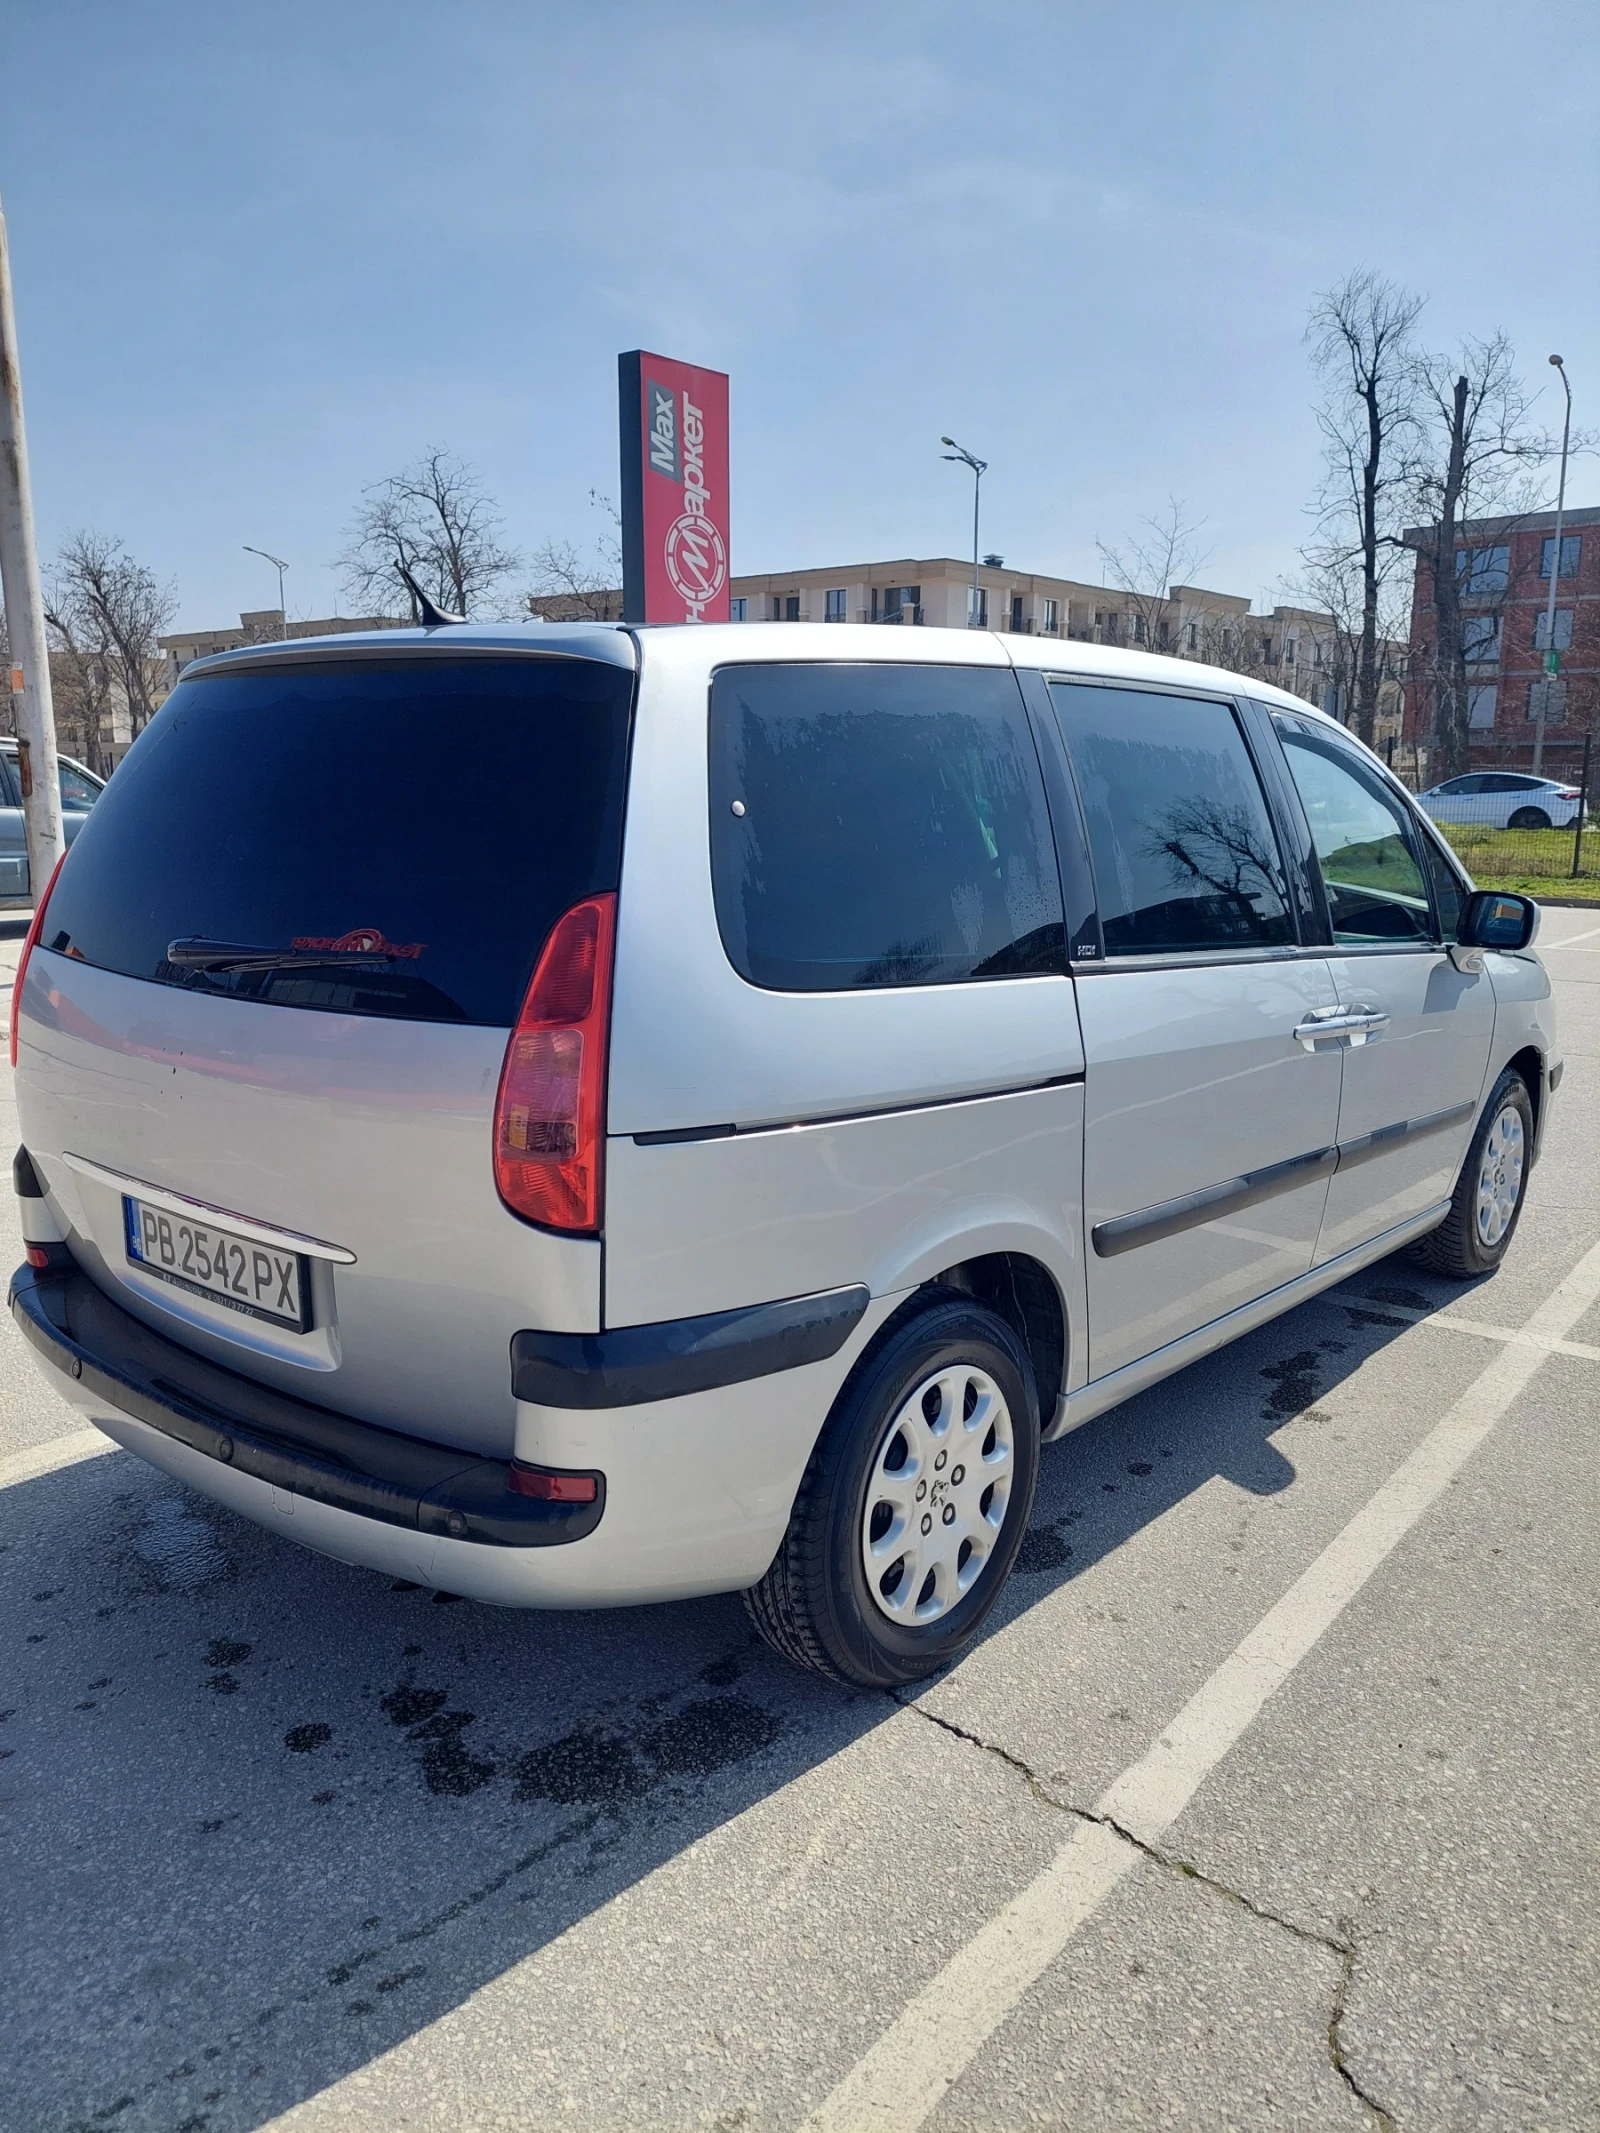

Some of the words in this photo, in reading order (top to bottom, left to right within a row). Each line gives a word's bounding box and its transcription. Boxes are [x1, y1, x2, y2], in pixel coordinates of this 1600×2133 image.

[651, 390, 675, 473] Max
[132, 1235, 142, 1251] BG
[972, 1324, 999, 1344] OUTSIDE
